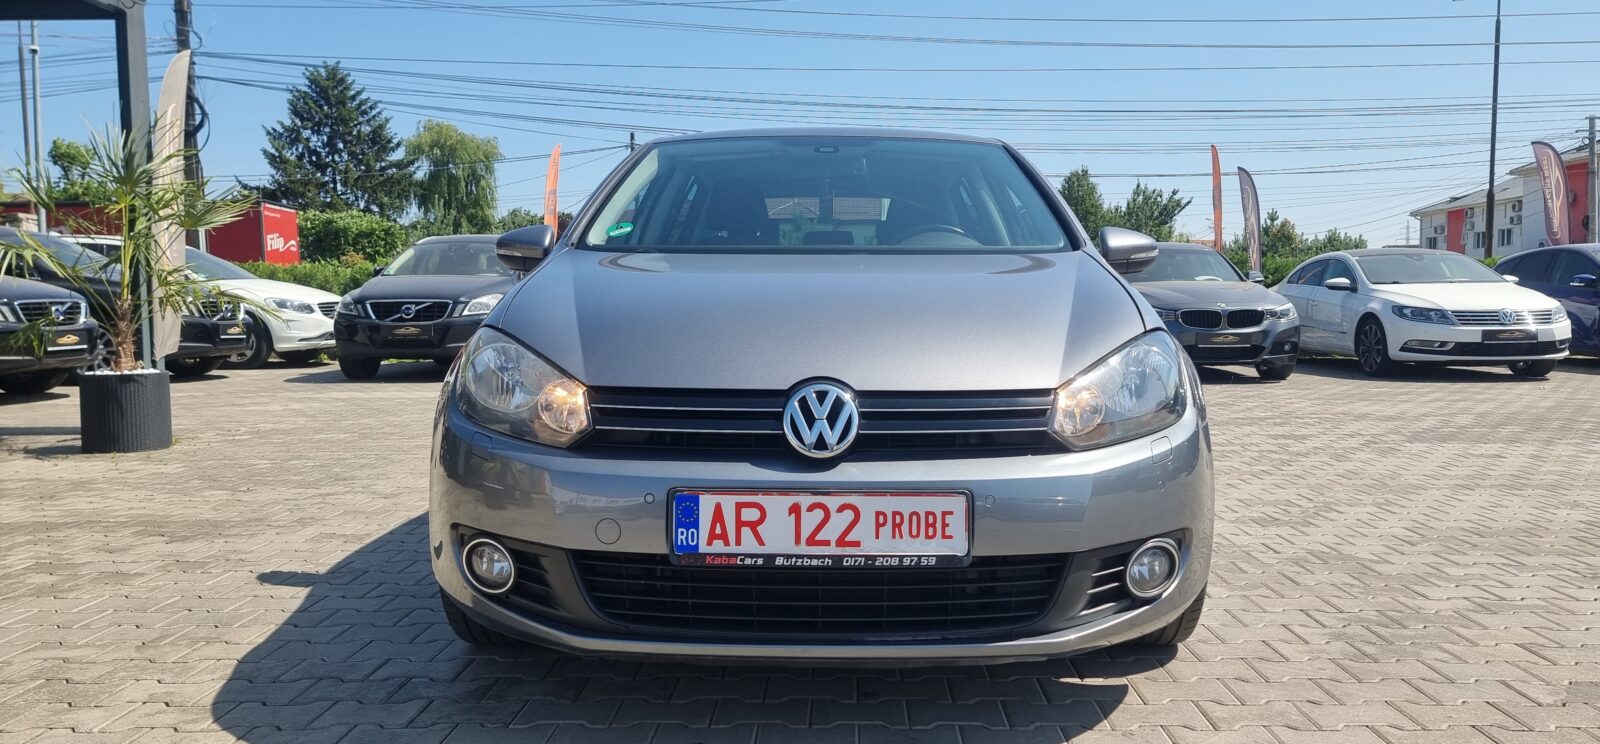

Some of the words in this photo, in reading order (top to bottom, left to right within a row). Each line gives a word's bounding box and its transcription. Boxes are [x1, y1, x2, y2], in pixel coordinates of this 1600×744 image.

[706, 501, 767, 547] AR
[788, 501, 861, 548] 122
[874, 510, 954, 540] PROBE
[677, 527, 698, 546] RO
[705, 555, 764, 565] KabaCars
[775, 556, 832, 566] Butzbach
[842, 557, 865, 566] 0171
[875, 557, 899, 566] 208
[902, 557, 918, 566] 97
[920, 557, 937, 566] 59
